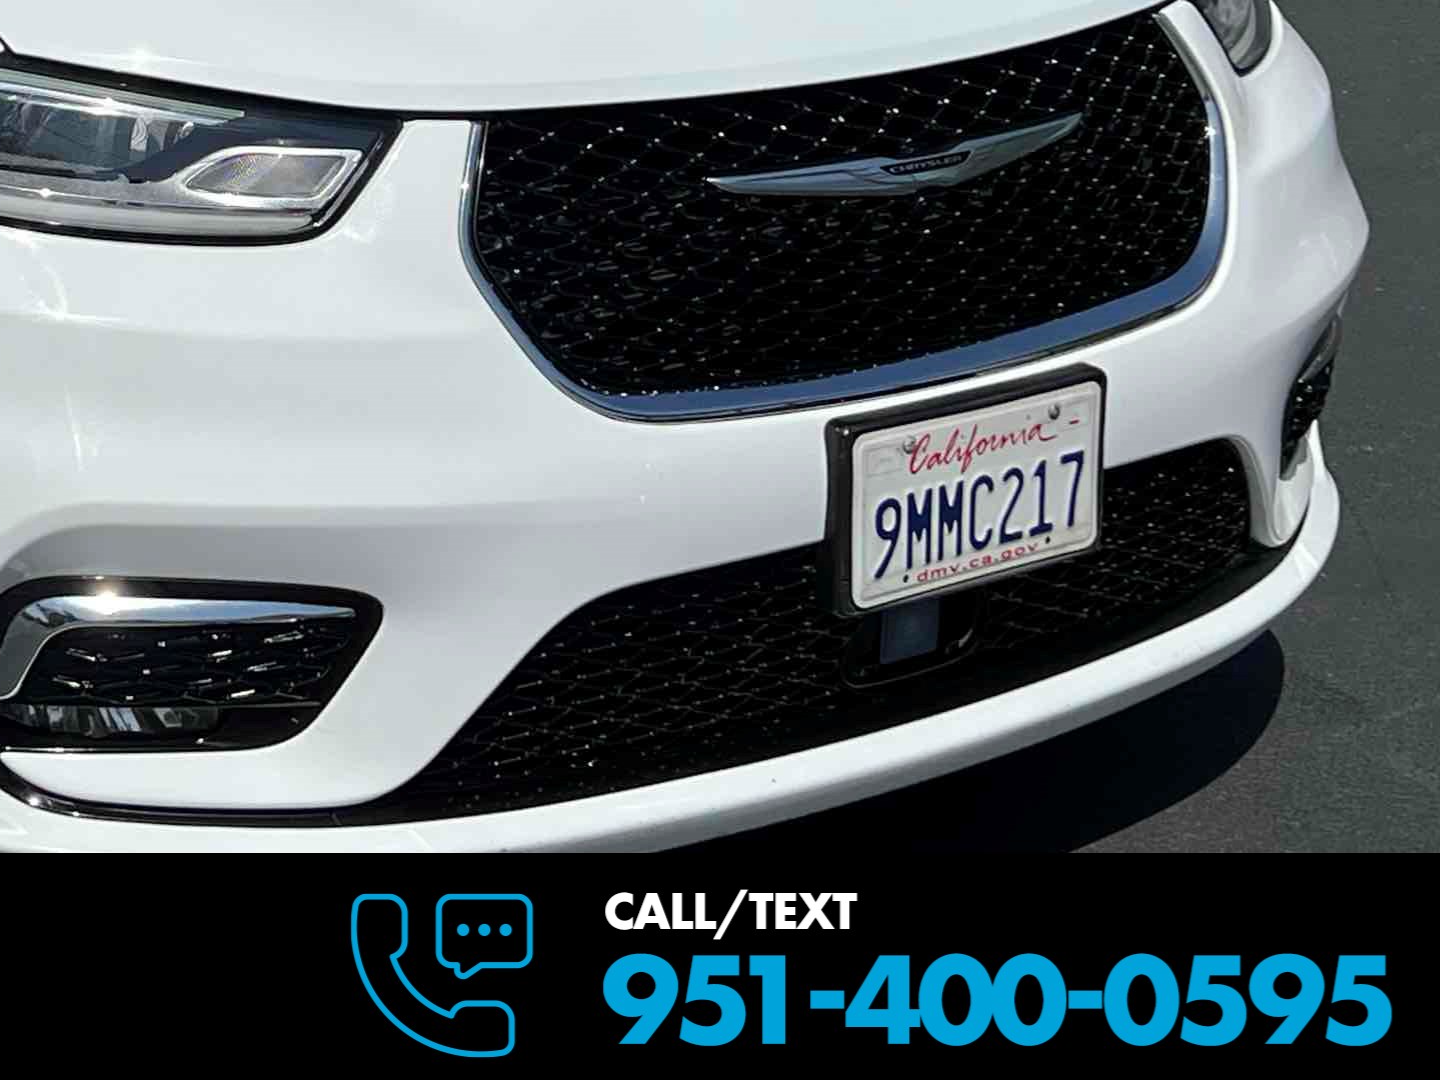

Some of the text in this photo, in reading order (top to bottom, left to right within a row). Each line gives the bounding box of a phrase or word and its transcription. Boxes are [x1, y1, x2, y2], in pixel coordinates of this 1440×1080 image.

[909, 423, 1057, 474] California
[874, 449, 1085, 580] 9MMC217
[916, 541, 1040, 583] dmv.ca.gov
